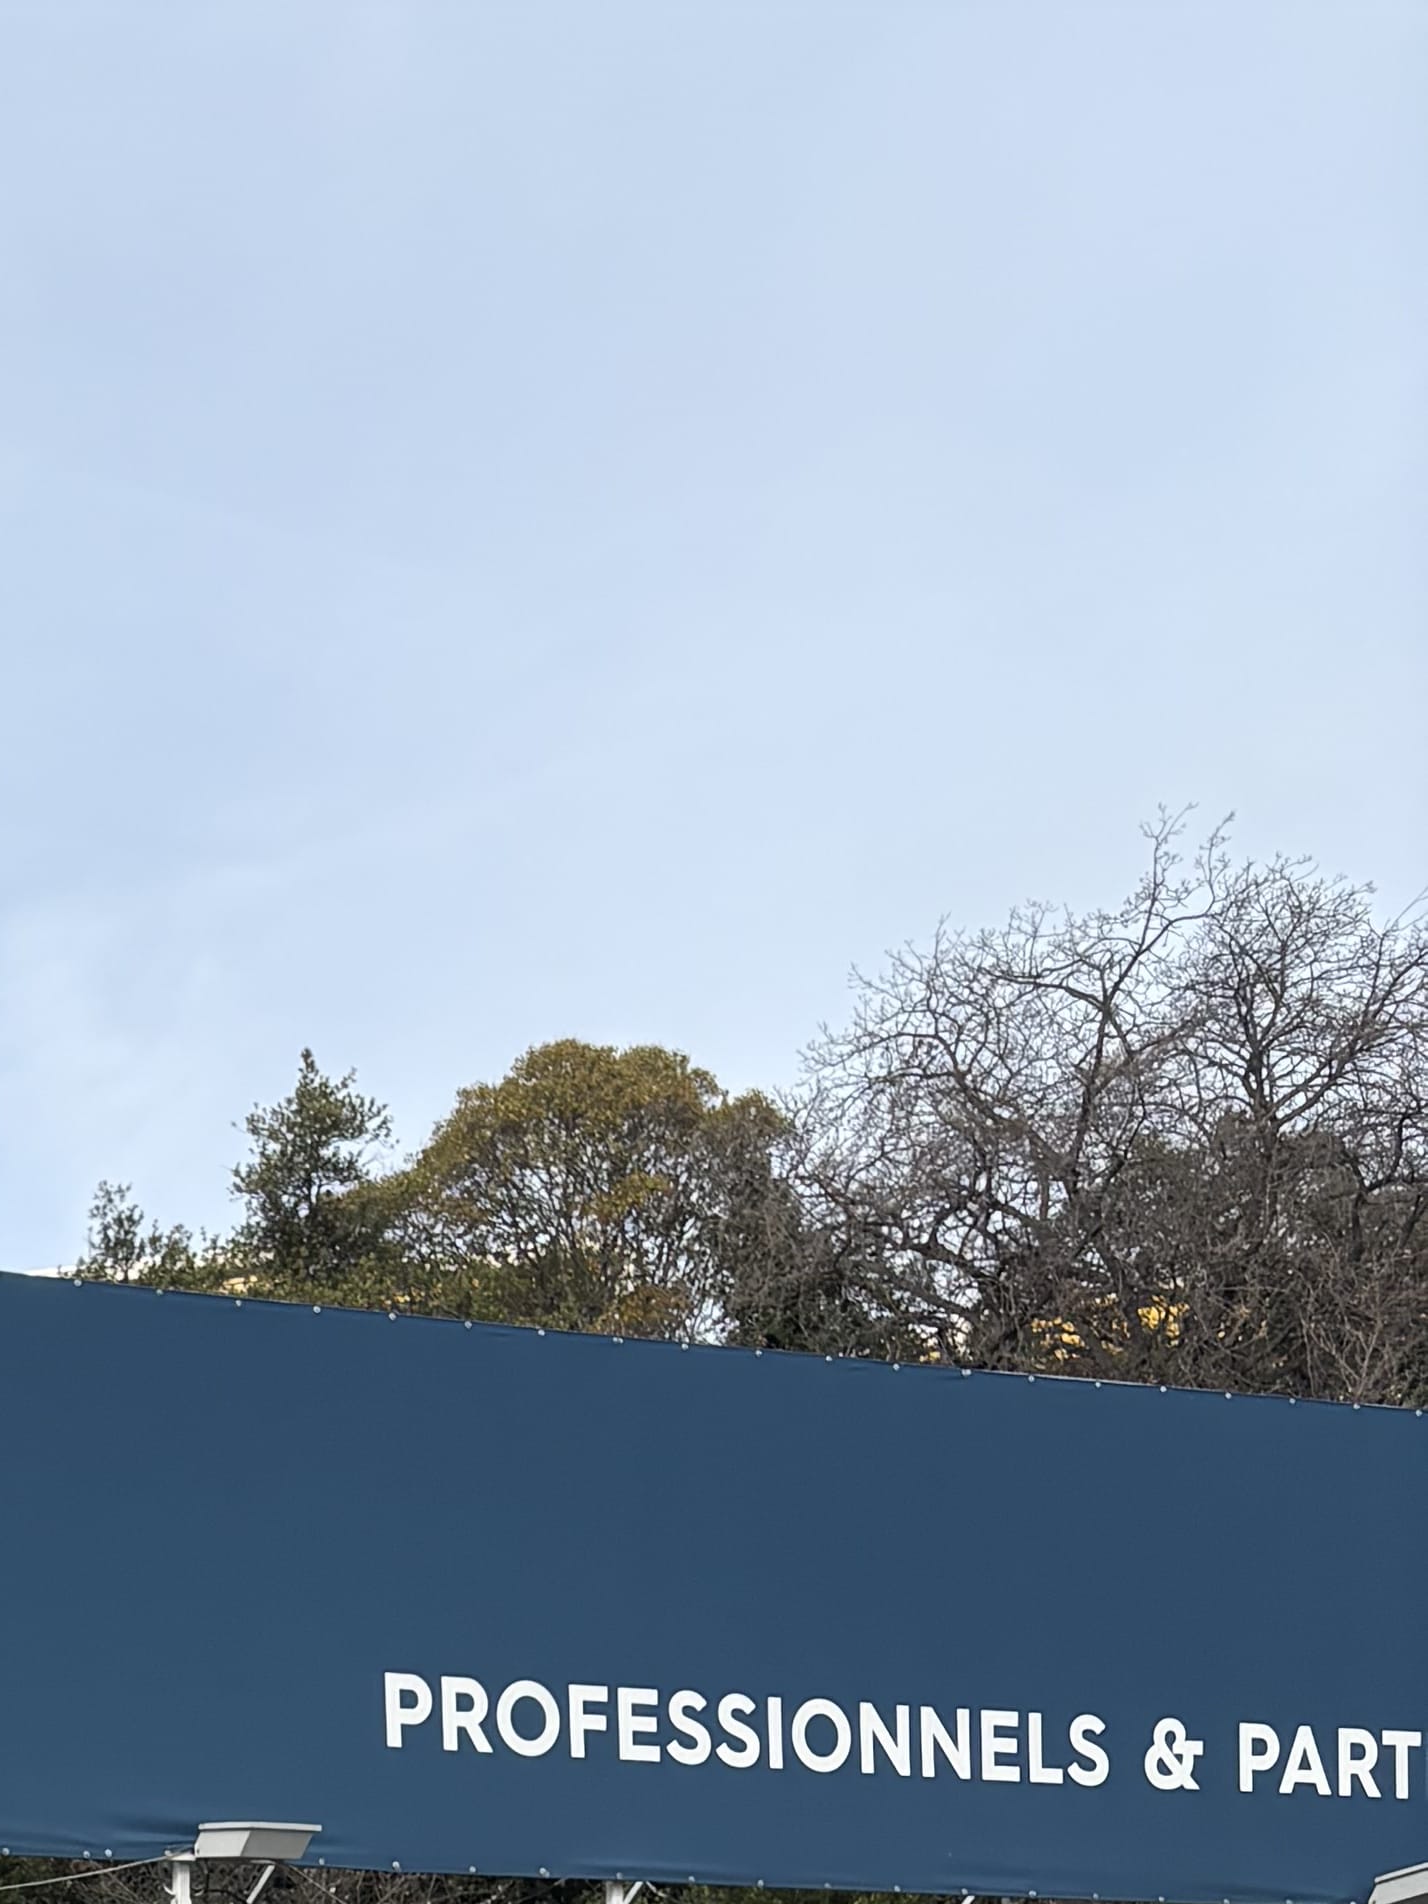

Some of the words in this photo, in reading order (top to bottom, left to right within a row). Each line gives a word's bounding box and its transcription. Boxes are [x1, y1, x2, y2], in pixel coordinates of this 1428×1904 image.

[384, 1671, 1110, 1788] PROFESSIONNELS
[1144, 1717, 1204, 1791] &
[1239, 1722, 1422, 1800] PART
